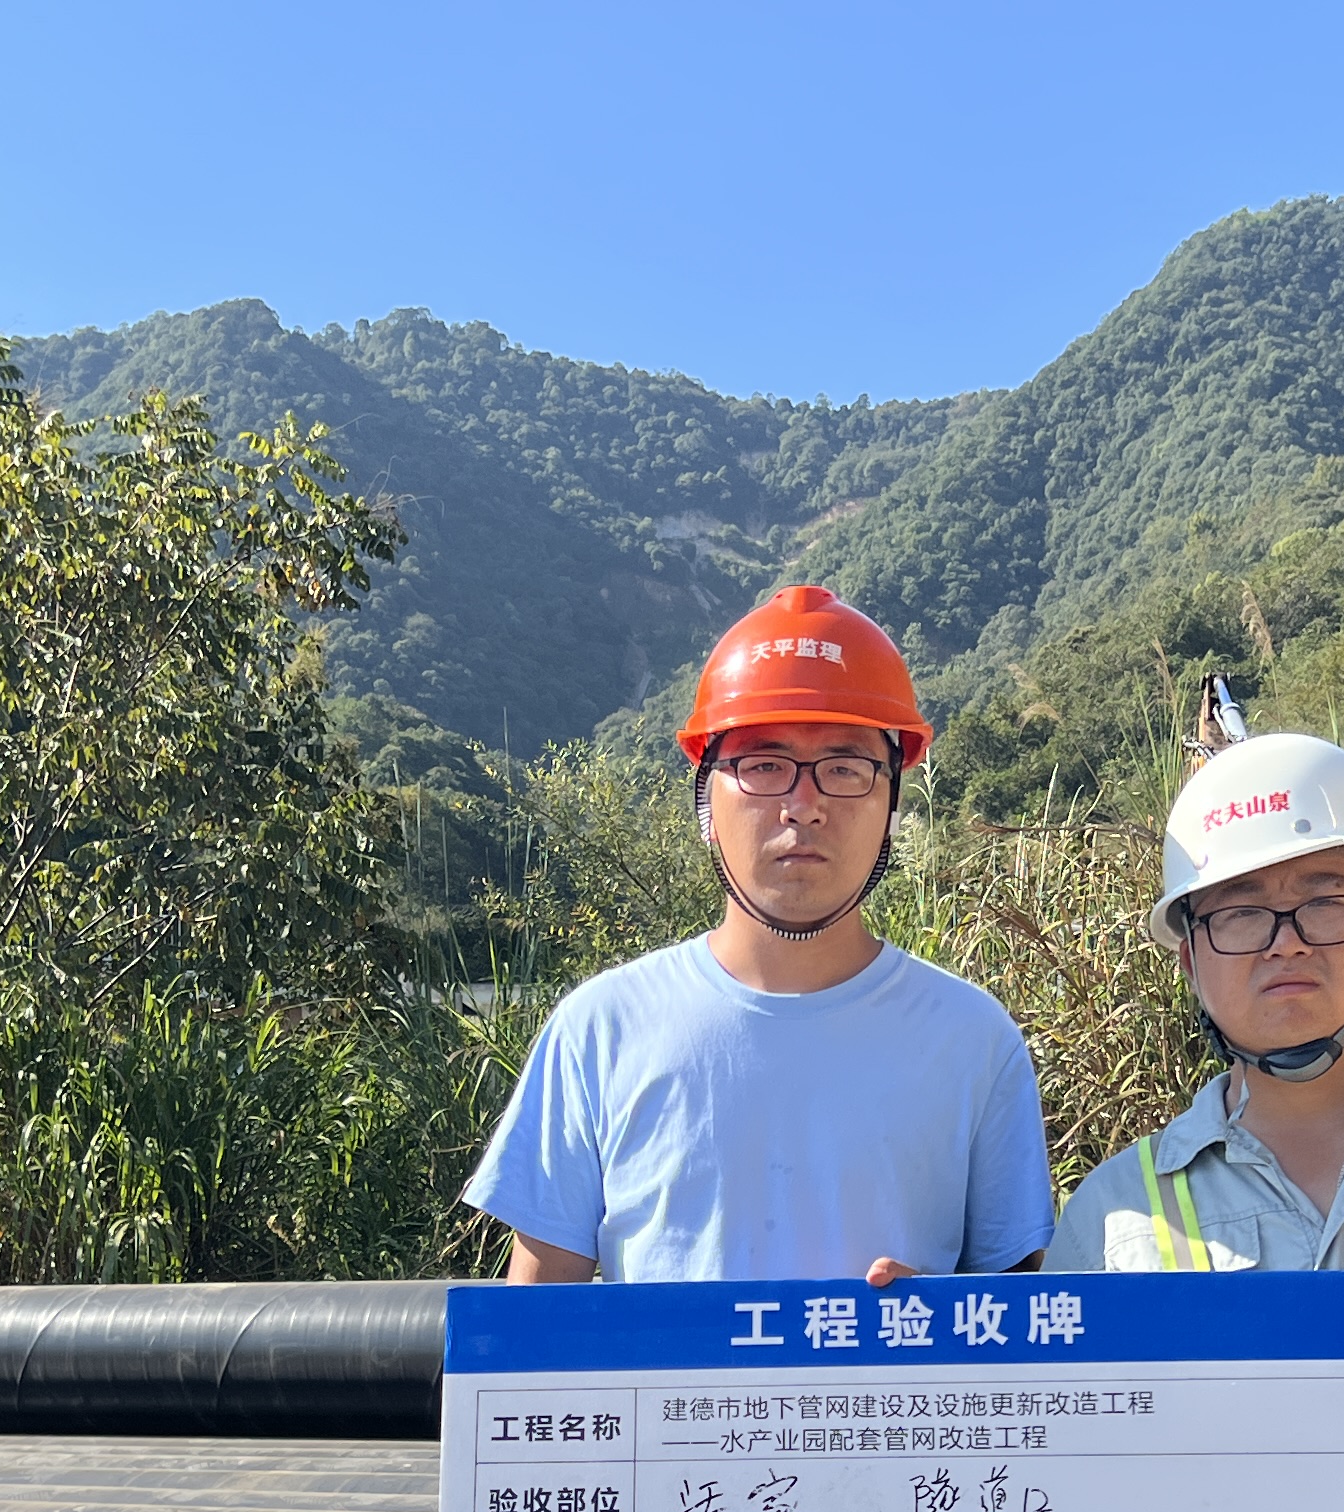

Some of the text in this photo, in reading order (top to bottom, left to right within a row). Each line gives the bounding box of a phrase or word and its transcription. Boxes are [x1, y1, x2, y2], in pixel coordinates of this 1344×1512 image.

[751, 638, 843, 664] 天平监理
[1203, 790, 1290, 832] 农夫山泉
[730, 1292, 1086, 1349] 工程验收牌
[663, 1390, 1156, 1421] 建德市地下管网建设及设施更新改造工程
[491, 1413, 622, 1442] 工程名称
